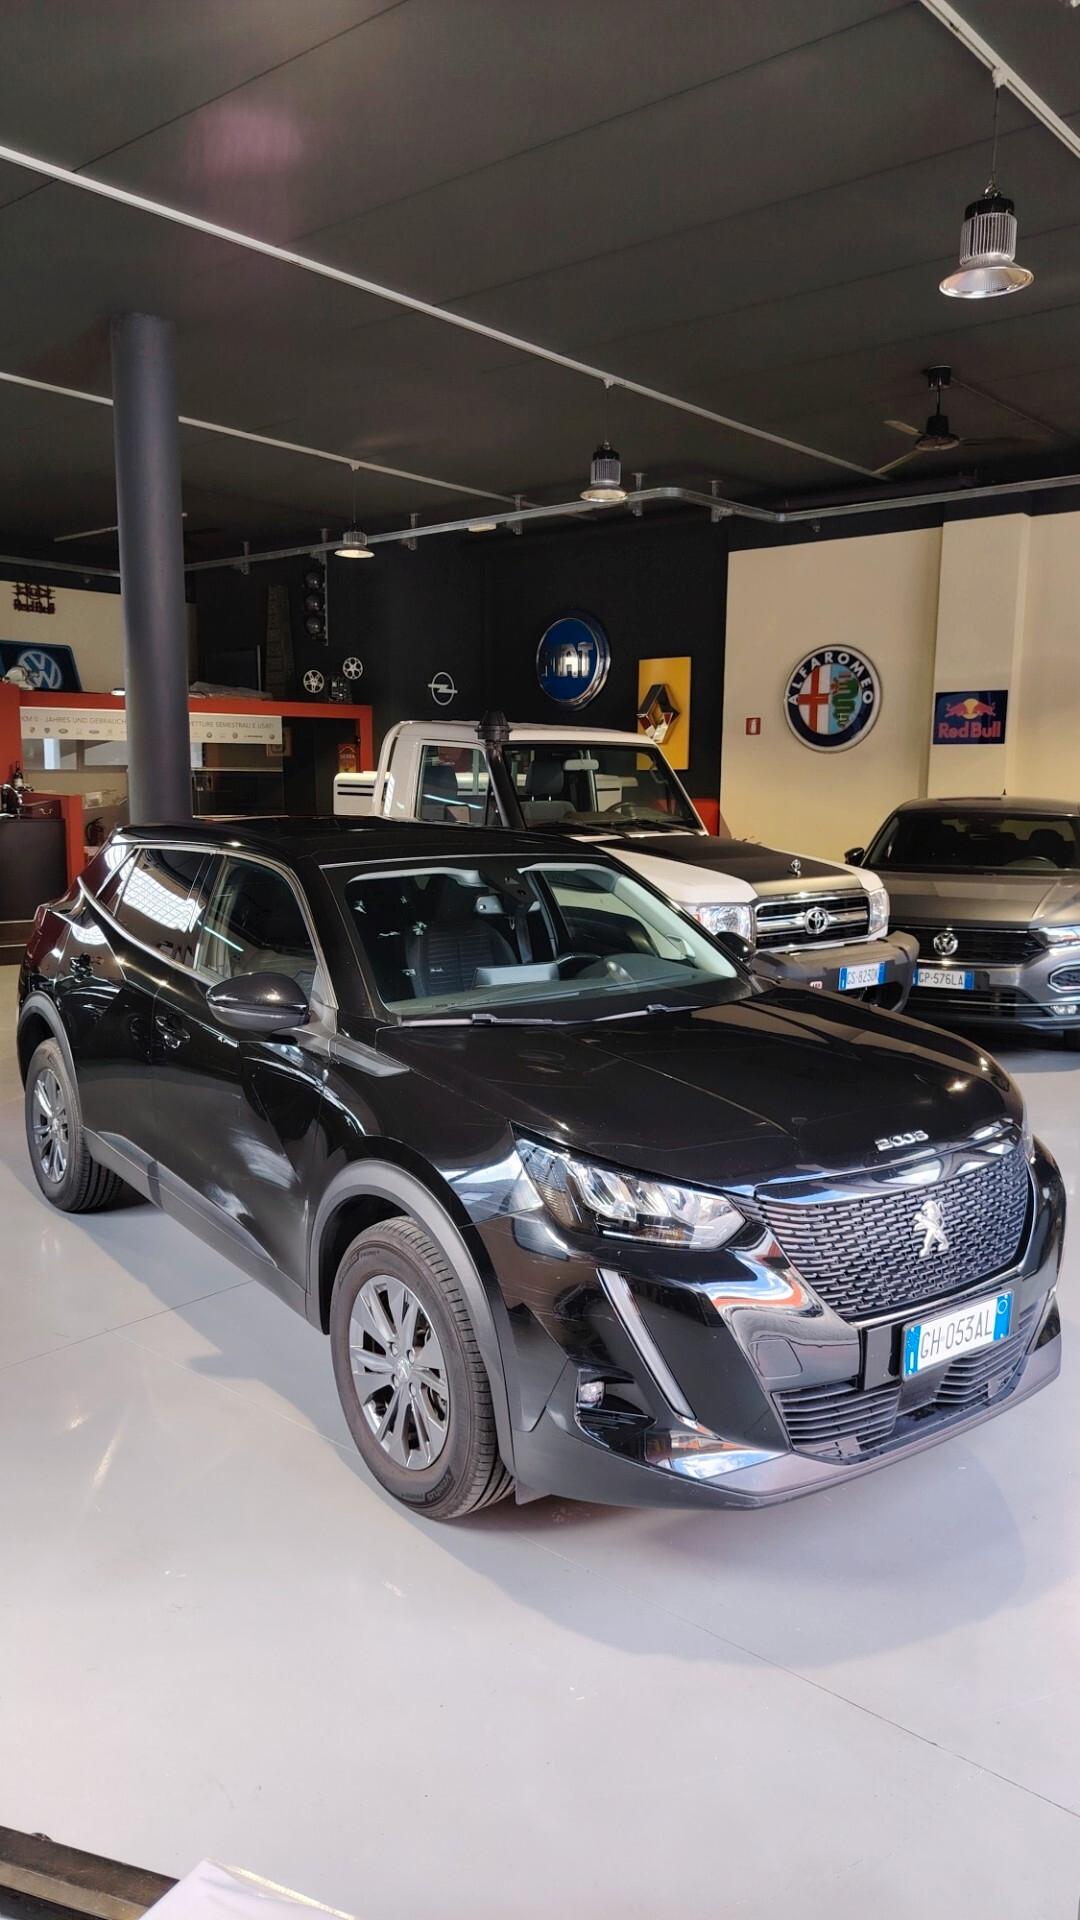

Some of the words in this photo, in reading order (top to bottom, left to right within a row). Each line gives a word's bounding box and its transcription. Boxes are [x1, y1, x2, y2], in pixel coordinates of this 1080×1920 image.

[541, 642, 593, 678] AT
[788, 657, 821, 706] ALFA
[825, 651, 874, 704] ROMEO
[938, 721, 969, 738] Red
[971, 721, 1001, 738] Bull
[875, 1130, 929, 1151] 2008
